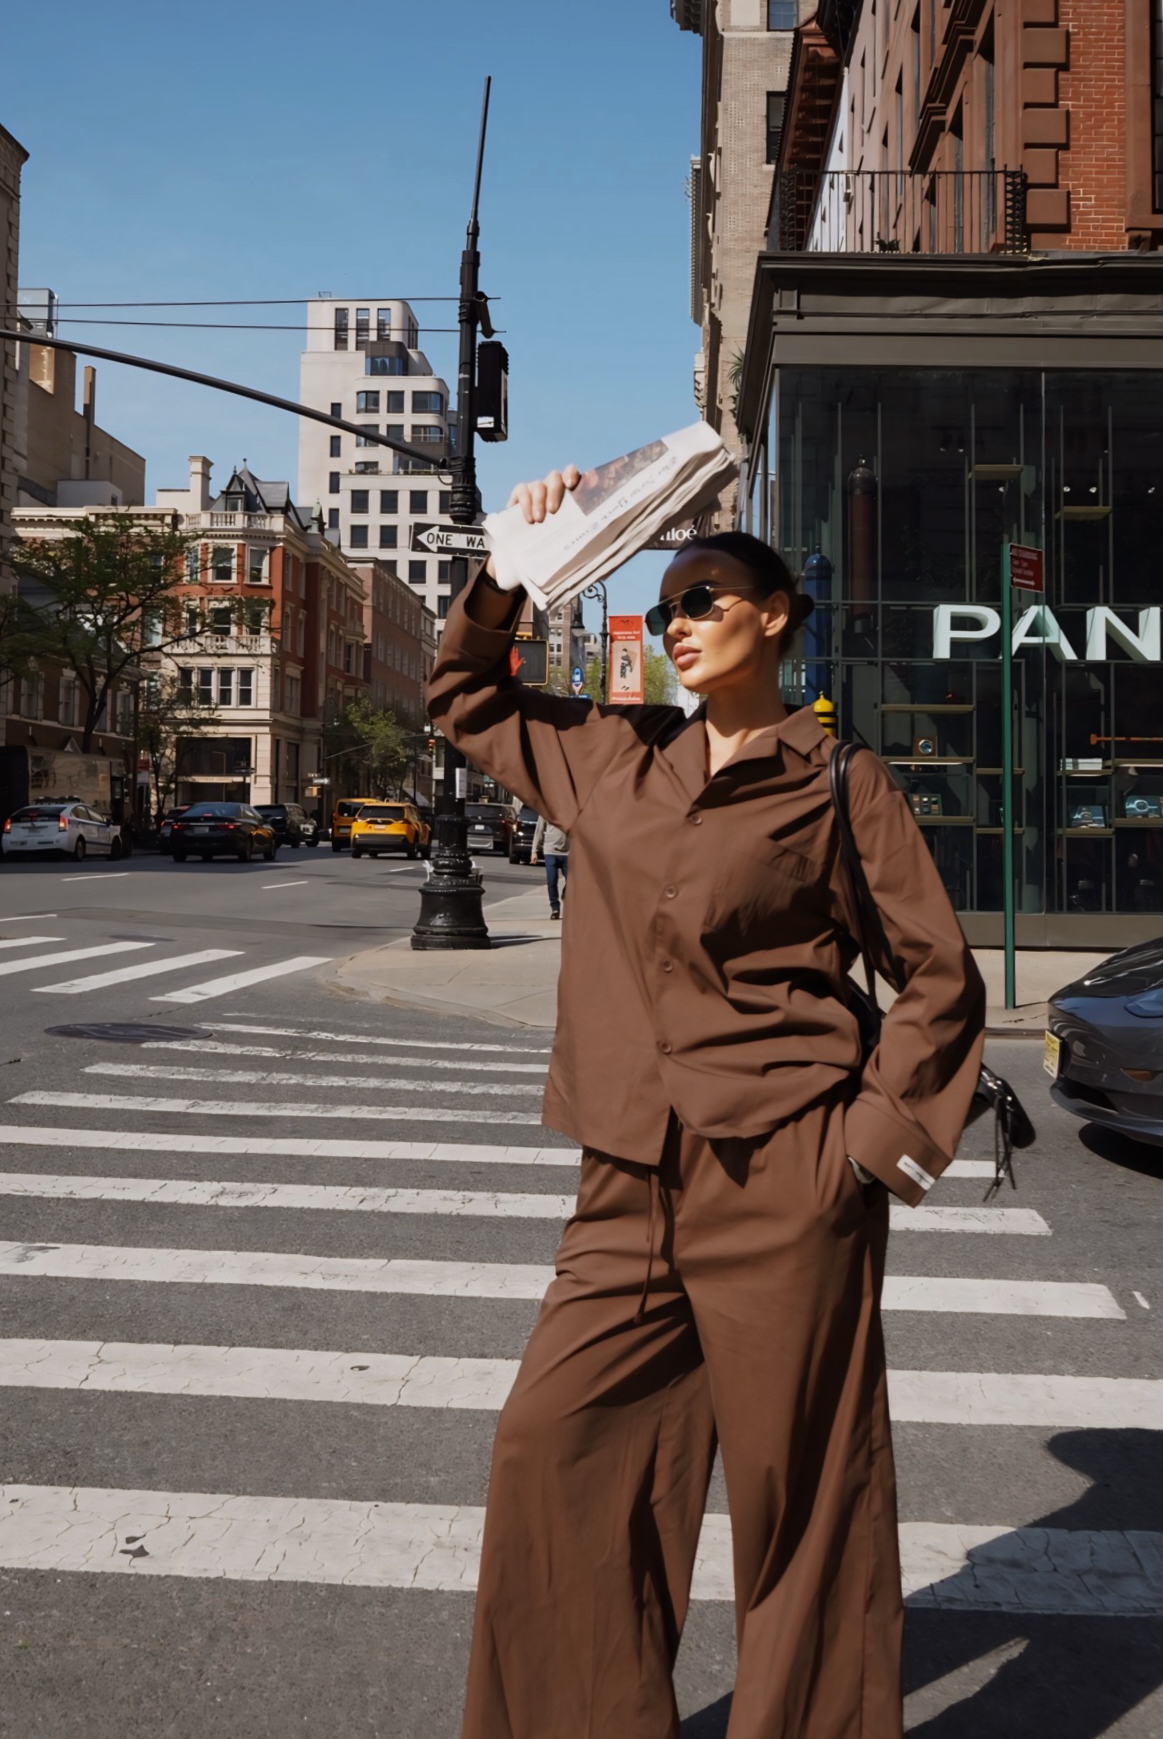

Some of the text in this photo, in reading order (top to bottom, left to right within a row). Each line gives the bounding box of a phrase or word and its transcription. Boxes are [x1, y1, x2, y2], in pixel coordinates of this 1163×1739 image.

[426, 532, 486, 549] ONE WA
[933, 604, 1161, 661] PAN
